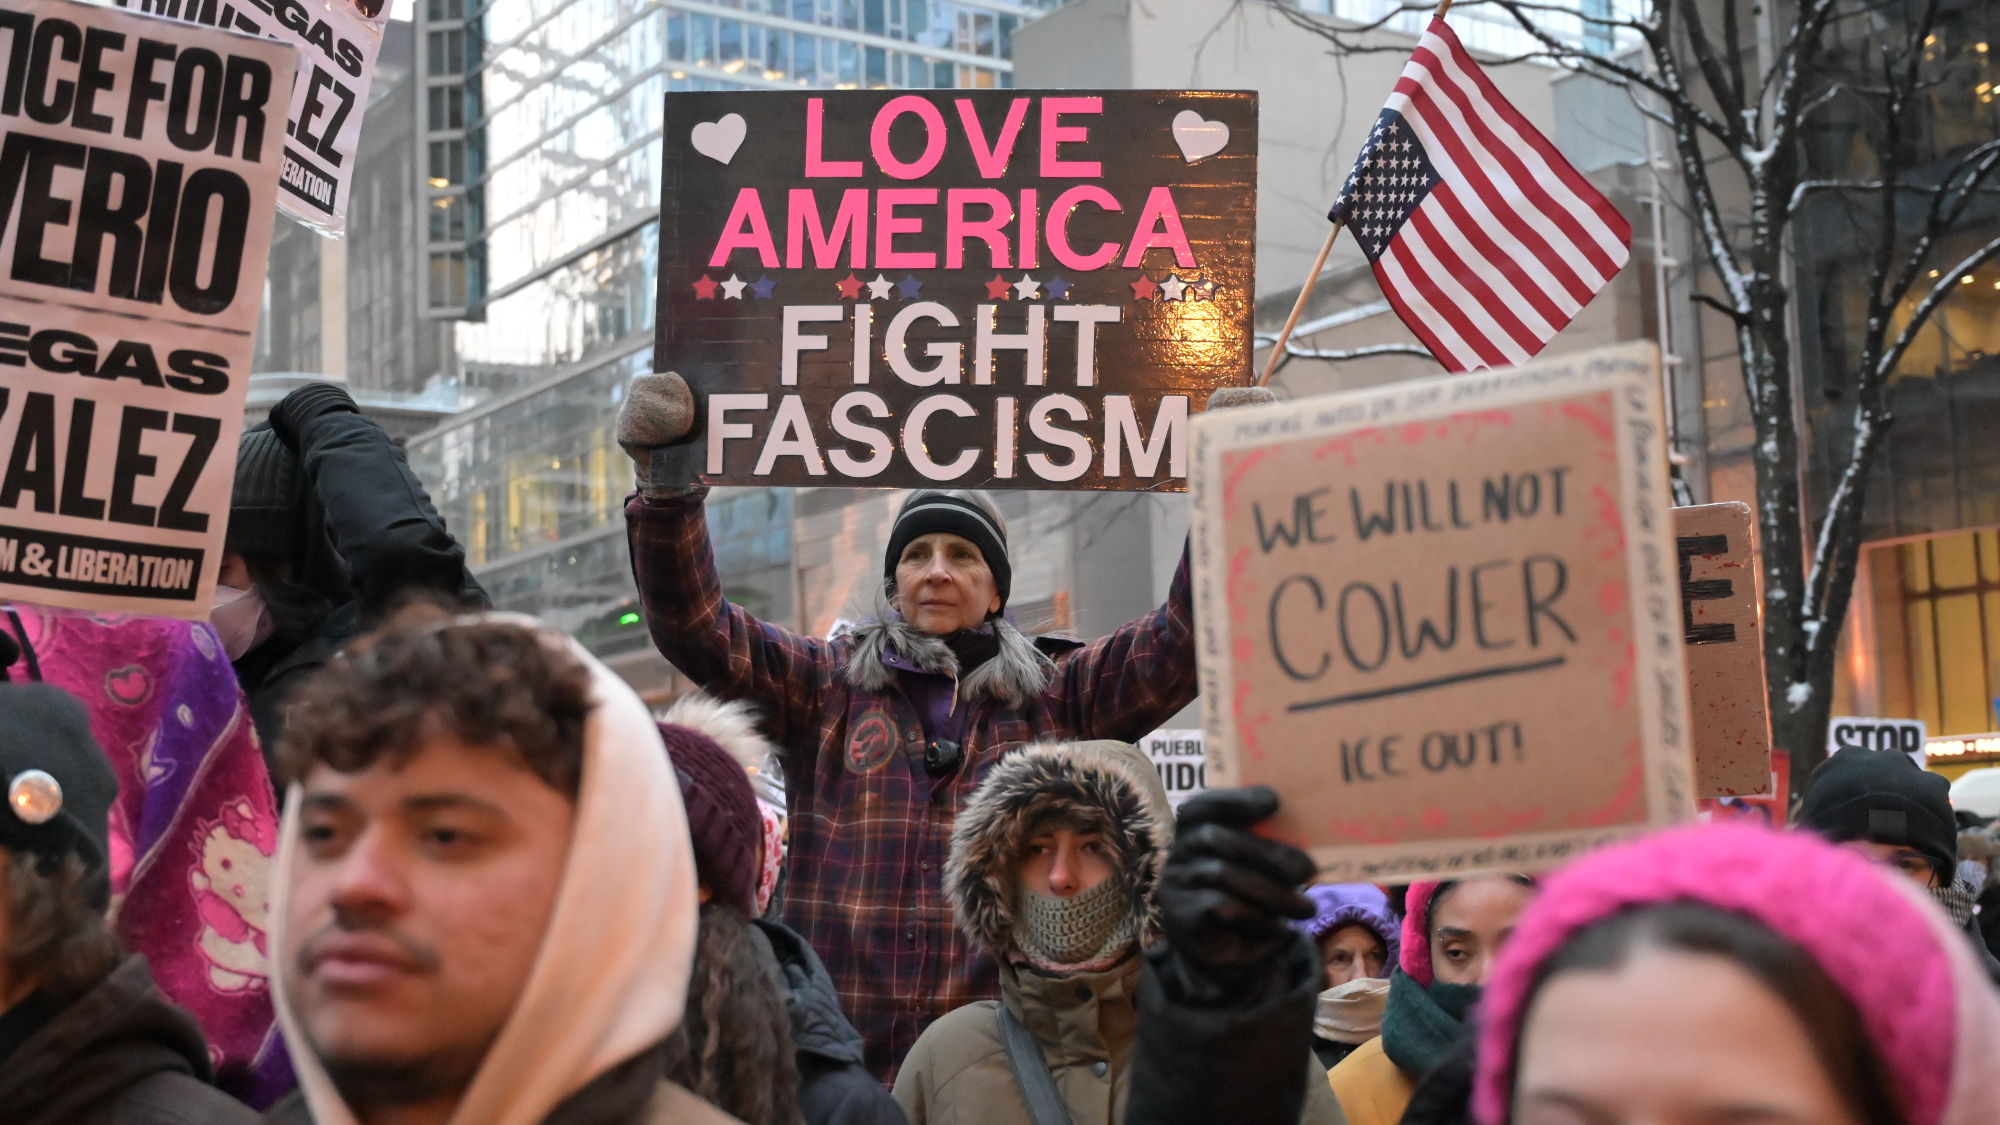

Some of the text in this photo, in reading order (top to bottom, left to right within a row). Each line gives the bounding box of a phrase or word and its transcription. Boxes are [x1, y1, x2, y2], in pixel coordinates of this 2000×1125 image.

[123, 37, 273, 164] FOR
[805, 95, 1103, 180] LOVE
[707, 184, 1198, 272] AMERICA
[780, 301, 1122, 387] FIGHT
[0, 386, 222, 534] ALEZ
[706, 393, 1189, 482] FASCISM
[1252, 465, 1573, 554] WE WILL NOT
[21, 542, 54, 577] &
[56, 545, 194, 590] LIBERATION
[1267, 553, 1579, 683] COWER
[1157, 763, 1206, 790] ID
[1339, 721, 1526, 784] ICE OUT!
[1834, 723, 1920, 753] STOP
